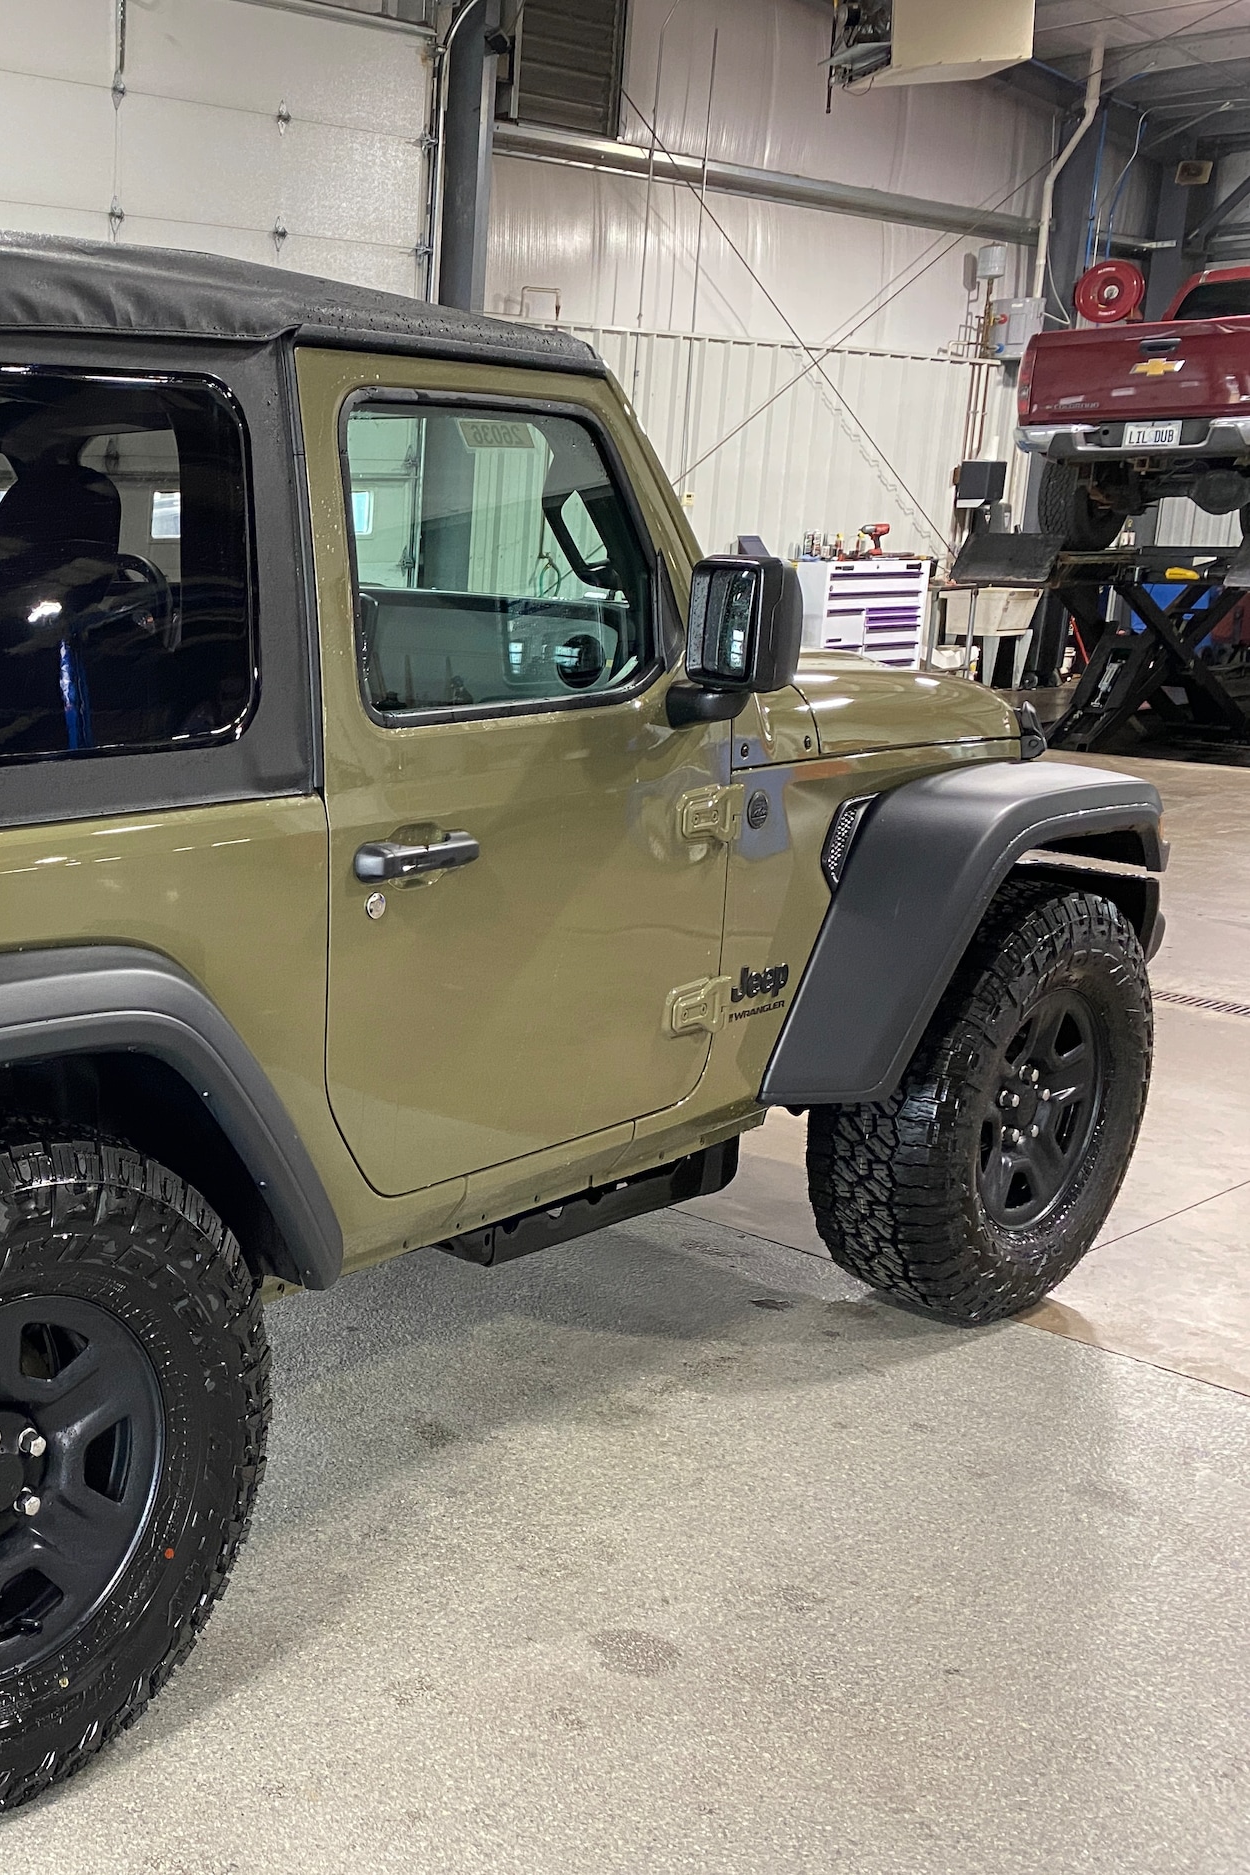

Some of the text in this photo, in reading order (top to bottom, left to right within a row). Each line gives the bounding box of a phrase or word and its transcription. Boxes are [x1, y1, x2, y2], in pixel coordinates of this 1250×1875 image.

[1128, 429, 1175, 444] LIL DUB
[730, 963, 789, 1003] Jeep
[733, 1000, 786, 1021] WRANGLER
